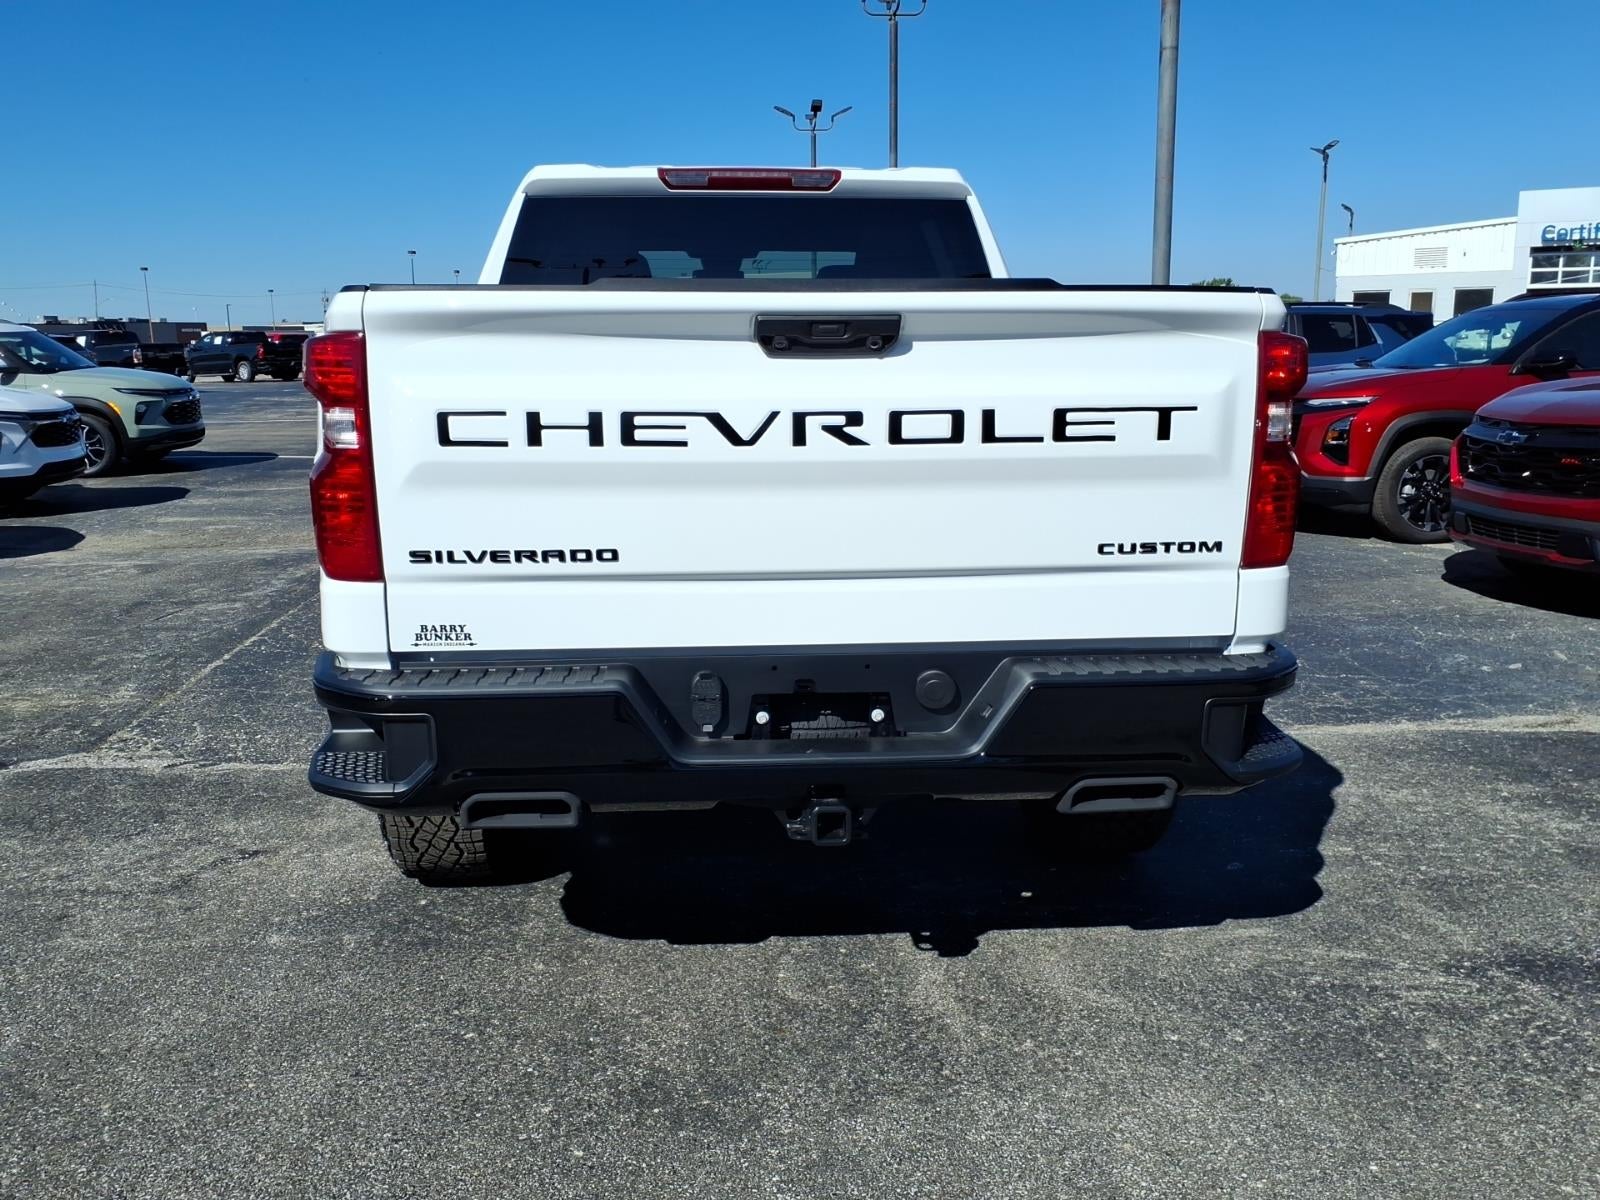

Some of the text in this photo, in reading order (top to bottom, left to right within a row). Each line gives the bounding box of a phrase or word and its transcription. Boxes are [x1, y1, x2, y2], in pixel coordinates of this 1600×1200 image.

[437, 406, 1198, 448] CHEVROLET
[1097, 540, 1223, 556] CUSTOM
[408, 548, 620, 565] SILVERADO
[419, 624, 467, 633] BARRY
[414, 632, 473, 642] BUNKER
